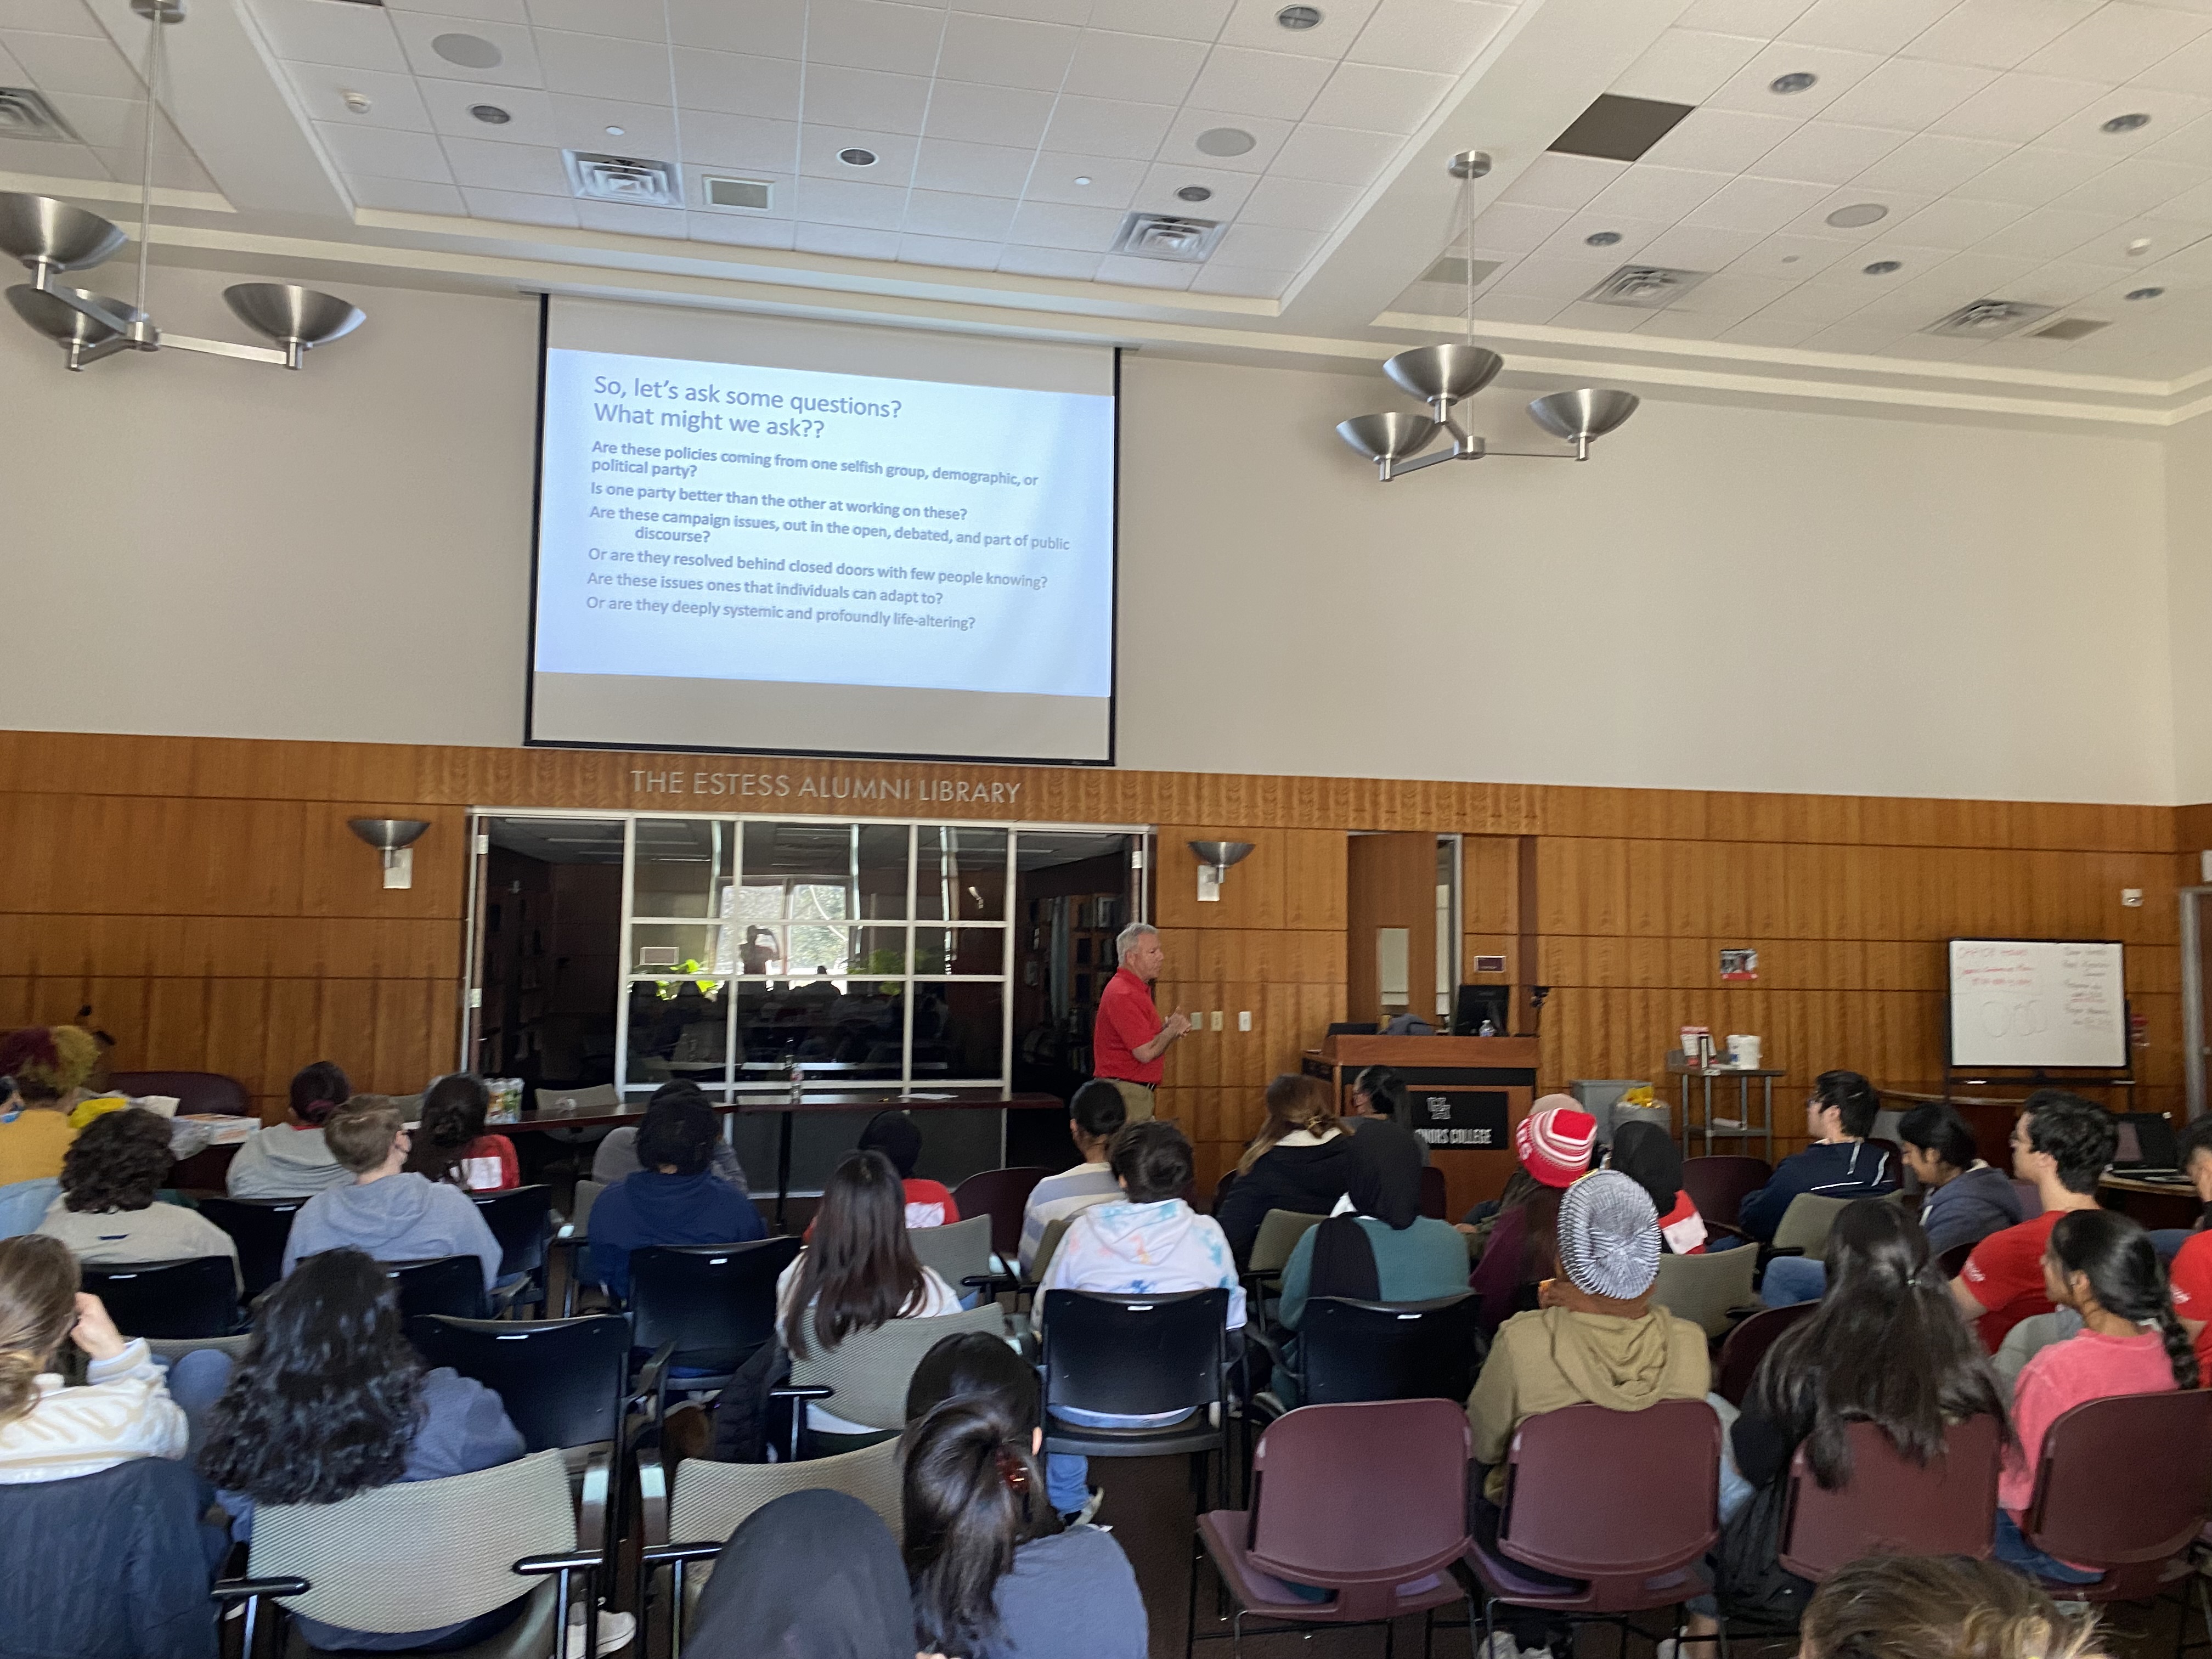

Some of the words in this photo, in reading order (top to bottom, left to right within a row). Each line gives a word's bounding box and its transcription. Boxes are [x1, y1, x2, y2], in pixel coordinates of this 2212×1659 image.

[594, 376, 627, 398] So,
[635, 378, 679, 399] let’s
[685, 384, 720, 403] ask
[725, 391, 783, 408] some
[790, 397, 902, 418] questions?
[594, 403, 654, 425] What
[661, 410, 723, 433] might
[729, 418, 760, 433] we
[766, 418, 825, 438] ask??
[591, 441, 618, 454] Are
[620, 442, 661, 457] these
[664, 447, 718, 461] policies
[720, 453, 772, 468] coming
[774, 454, 808, 468] from
[810, 460, 838, 471] one
[840, 460, 883, 474] selfish
[885, 466, 929, 480] group,
[932, 467, 1021, 487] demographic,
[1023, 477, 1039, 486] or
[591, 459, 648, 473] political
[651, 465, 697, 479] party?
[591, 482, 603, 494] Is
[605, 486, 634, 496] one
[637, 487, 676, 502] party
[679, 488, 724, 503] better
[726, 492, 758, 505] than
[761, 494, 785, 507] the
[787, 496, 827, 510] other
[828, 501, 843, 511] at
[845, 501, 900, 518] working
[902, 507, 921, 517] on
[923, 506, 968, 520] these?
[589, 506, 616, 518] Are
[618, 507, 659, 522] these
[661, 513, 731, 529] campaign
[733, 515, 780, 532] issues,
[783, 521, 808, 532] out
[810, 521, 823, 533] in
[826, 521, 850, 534] the
[851, 526, 891, 540] open,
[894, 526, 953, 544] debated,
[955, 532, 981, 544] and
[983, 535, 1012, 547] part
[1013, 534, 1029, 546] of
[1031, 537, 1070, 550] public
[635, 526, 710, 543] discourse?
[588, 548, 608, 560] Or
[609, 551, 635, 562] are
[637, 550, 670, 566] they
[673, 553, 733, 568] resolved
[737, 556, 786, 571] behind
[788, 560, 833, 574] closed
[836, 562, 875, 577] doors
[877, 566, 907, 579] with
[910, 567, 935, 581] few
[938, 571, 983, 585] people
[985, 572, 1048, 590] knowing?
[587, 572, 613, 585] Are
[616, 573, 658, 587] these
[661, 575, 704, 590] issues
[706, 581, 741, 592] ones
[743, 580, 774, 594] that
[775, 582, 850, 599] individuals
[852, 588, 877, 600] can
[879, 589, 919, 605] adapt
[921, 591, 943, 605] to?
[586, 596, 606, 608] Or
[608, 600, 633, 610] are
[635, 598, 669, 614] they
[671, 600, 721, 617] deeply
[723, 605, 783, 618] systemic
[786, 607, 812, 619] and
[816, 609, 891, 627] profoundly
[893, 612, 976, 631] life-altering?
[630, 770, 684, 793] THE
[693, 772, 791, 797] ESTESS
[798, 776, 910, 800] ALUMNI
[919, 779, 1022, 804] LIBRARY
[1449, 1128, 1492, 1144] COLLEGE
